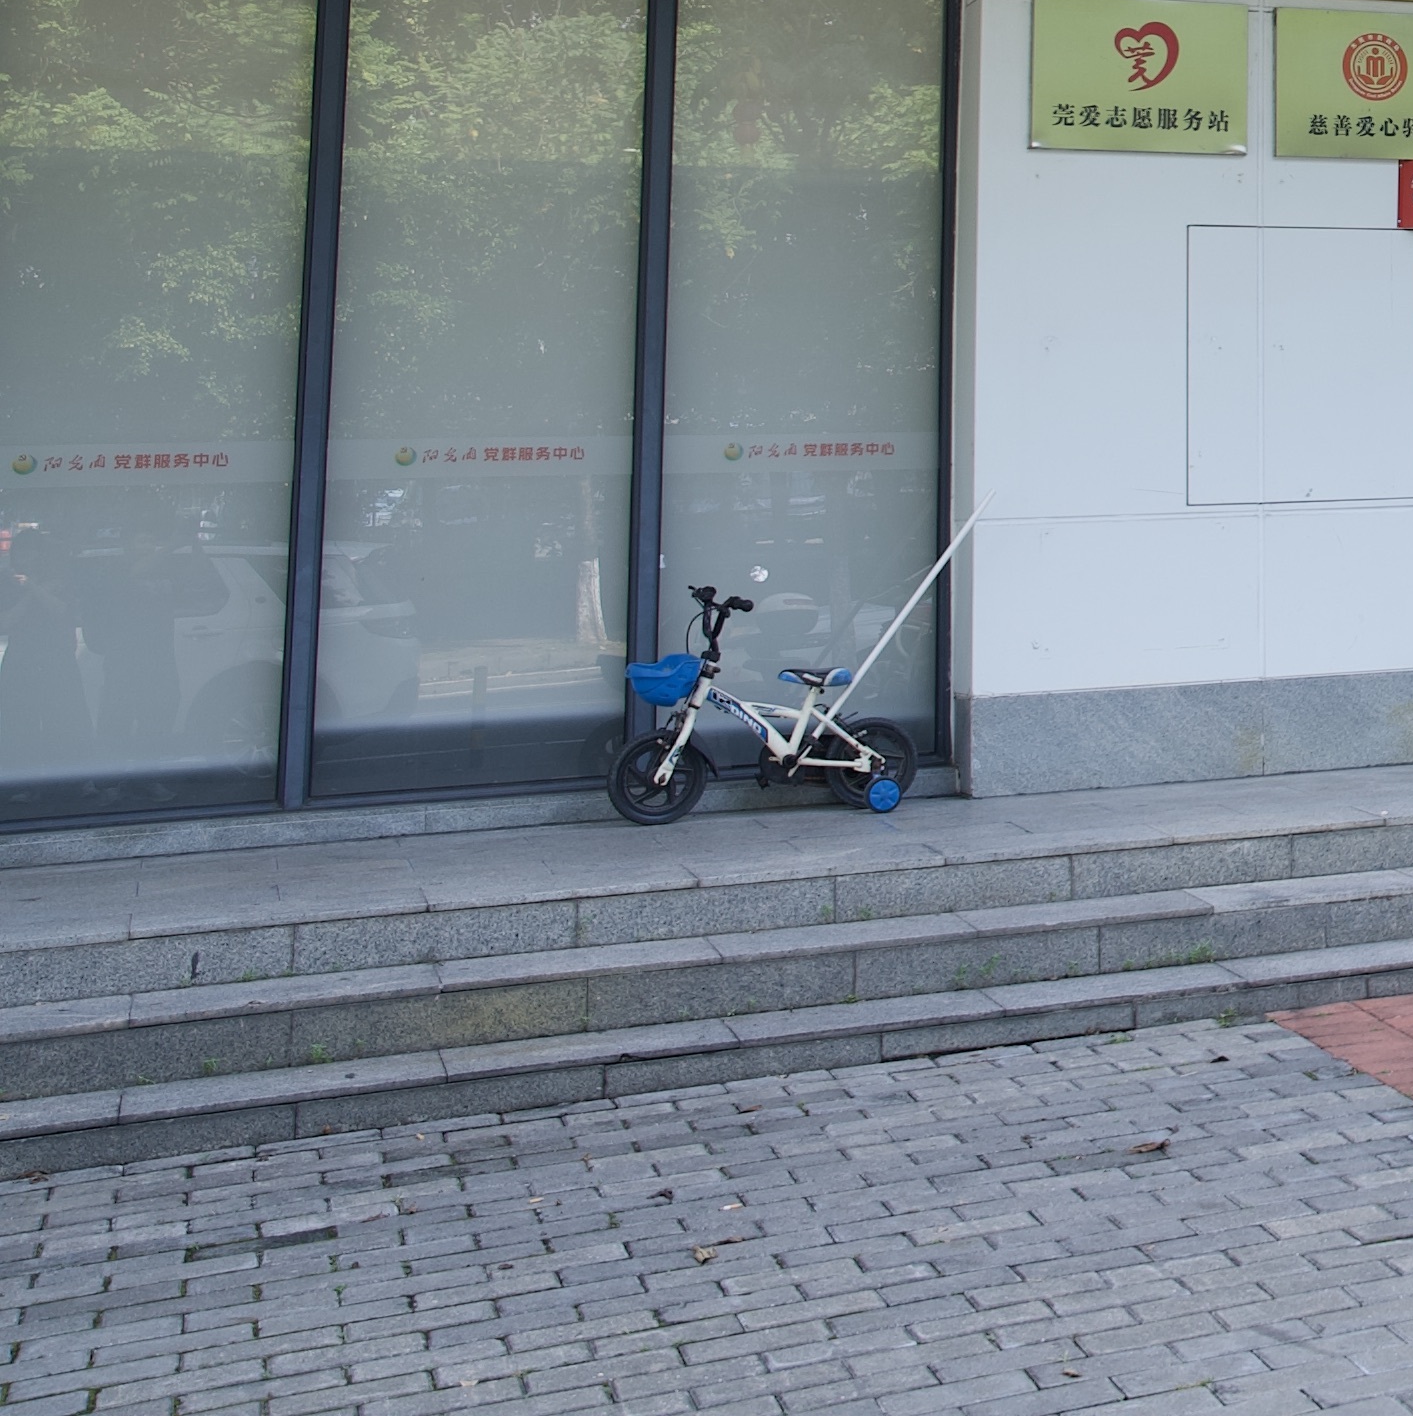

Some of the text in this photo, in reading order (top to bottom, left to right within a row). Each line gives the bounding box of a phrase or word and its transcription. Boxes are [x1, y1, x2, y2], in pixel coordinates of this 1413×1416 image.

[1052, 103, 1230, 132] 莞爱志愿服务站
[483, 446, 585, 462] 党群服务中心
[803, 442, 895, 457] 党群服务中心
[114, 452, 229, 470] 党群服务中心
